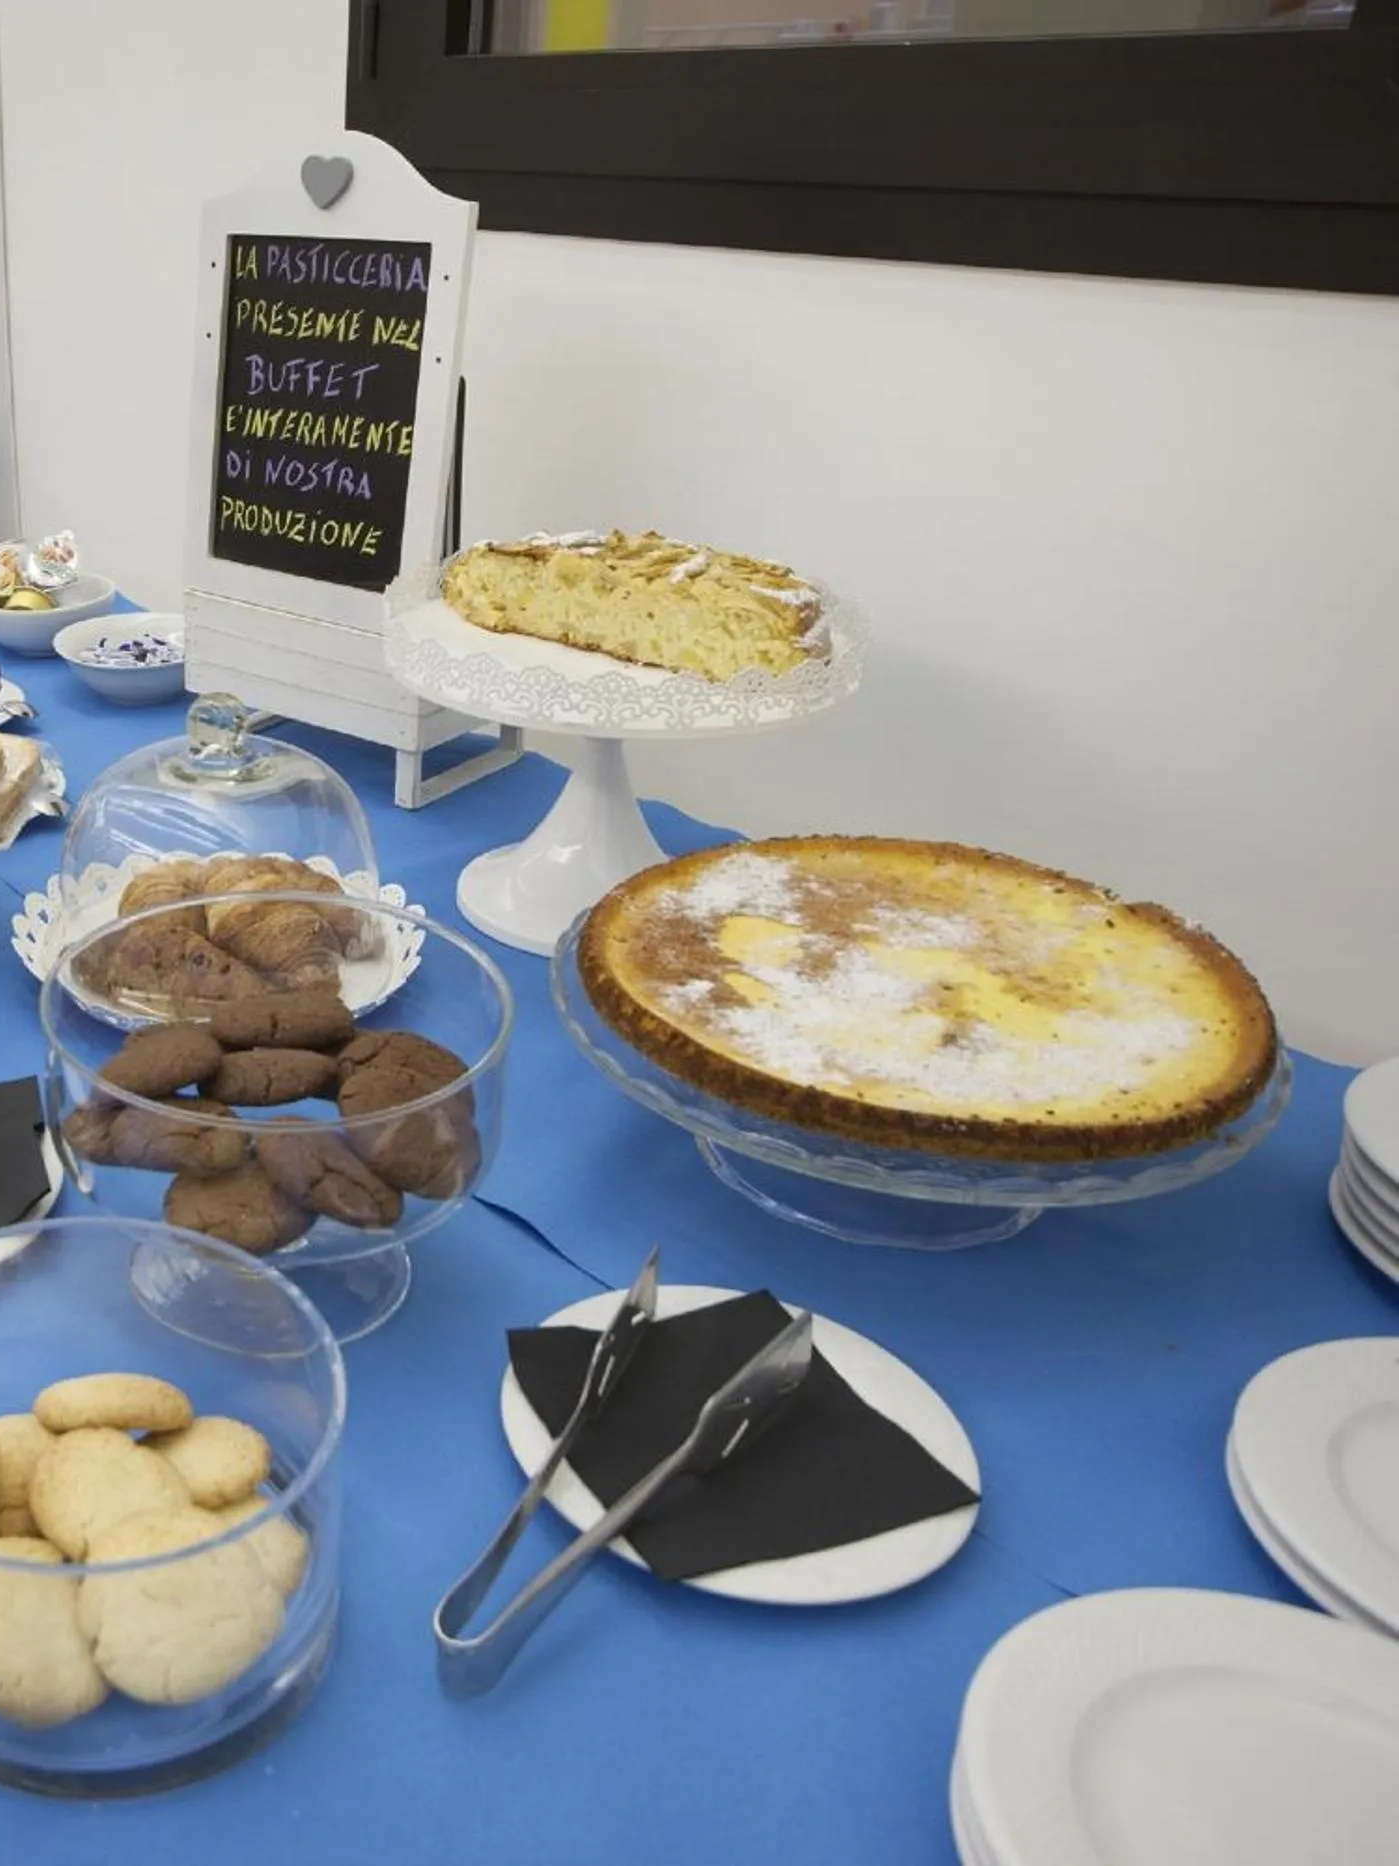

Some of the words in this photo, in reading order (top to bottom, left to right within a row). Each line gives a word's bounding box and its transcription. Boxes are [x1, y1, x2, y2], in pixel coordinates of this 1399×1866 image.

[236, 245, 258, 279] LA
[234, 298, 365, 342] PRESENTE
[371, 315, 422, 351] NEL
[245, 354, 380, 400] BUFFET
[264, 454, 372, 500] NOSTRA
